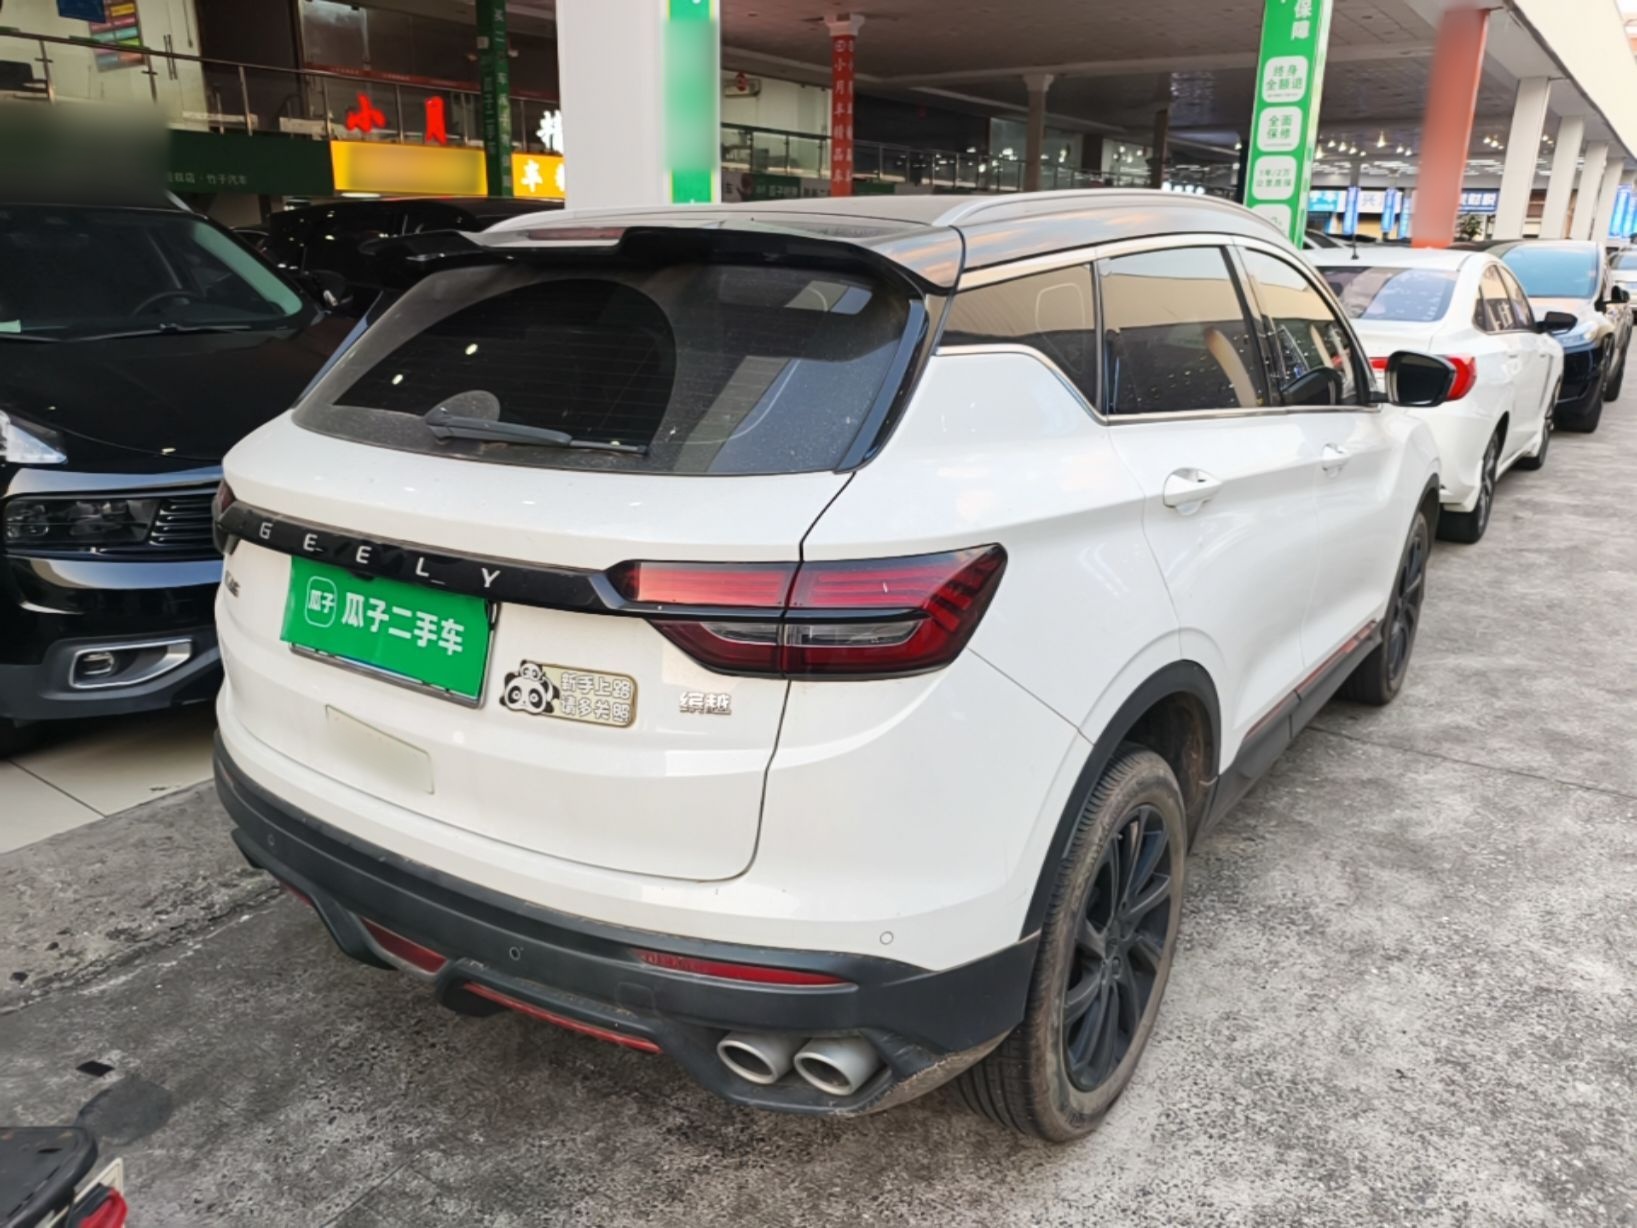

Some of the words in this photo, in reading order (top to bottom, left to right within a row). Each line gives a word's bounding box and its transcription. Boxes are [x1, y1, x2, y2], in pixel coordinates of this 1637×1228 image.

[1268, 114, 1293, 128] 全面
[258, 521, 501, 588] GEELY
[307, 589, 336, 614] 瓜子
[341, 592, 465, 656] 瓜子二手车
[560, 672, 632, 699] 新手上路
